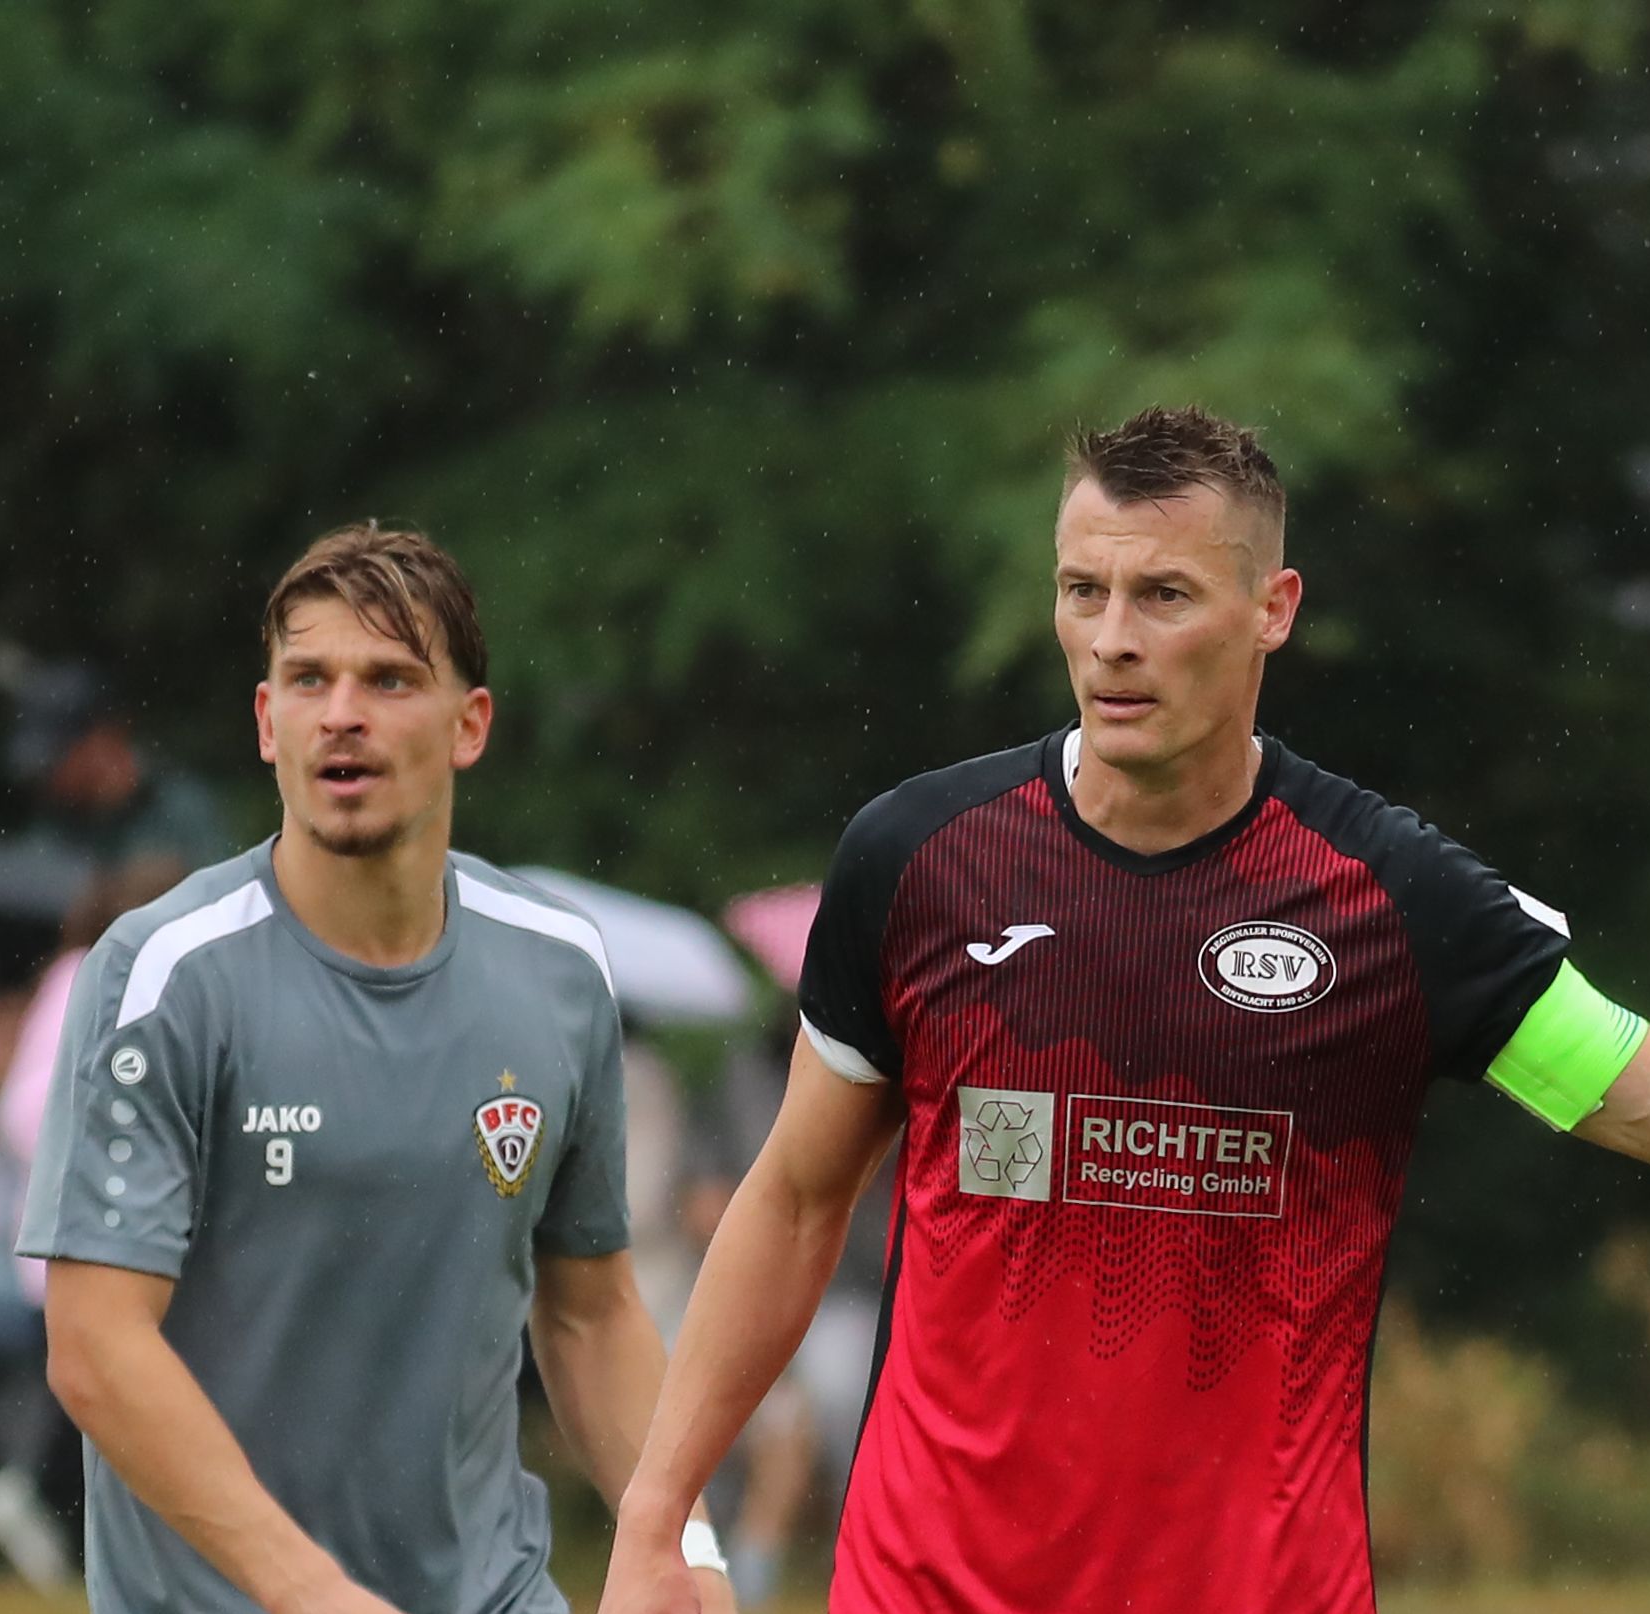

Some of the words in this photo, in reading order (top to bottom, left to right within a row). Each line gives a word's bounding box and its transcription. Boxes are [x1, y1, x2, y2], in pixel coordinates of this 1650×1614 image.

[1209, 927, 1268, 955] REGIONALER
[1269, 927, 1328, 966] SPORTVEREIN
[1231, 950, 1307, 982] RSV
[1220, 984, 1275, 1008] EINTRACHT
[242, 1105, 321, 1133] JAKO
[481, 1103, 538, 1133] BFC
[1082, 1117, 1273, 1166] RICHTER
[265, 1138, 293, 1187] 9
[1080, 1161, 1195, 1196] Recycling
[1201, 1172, 1272, 1195] GmbH
